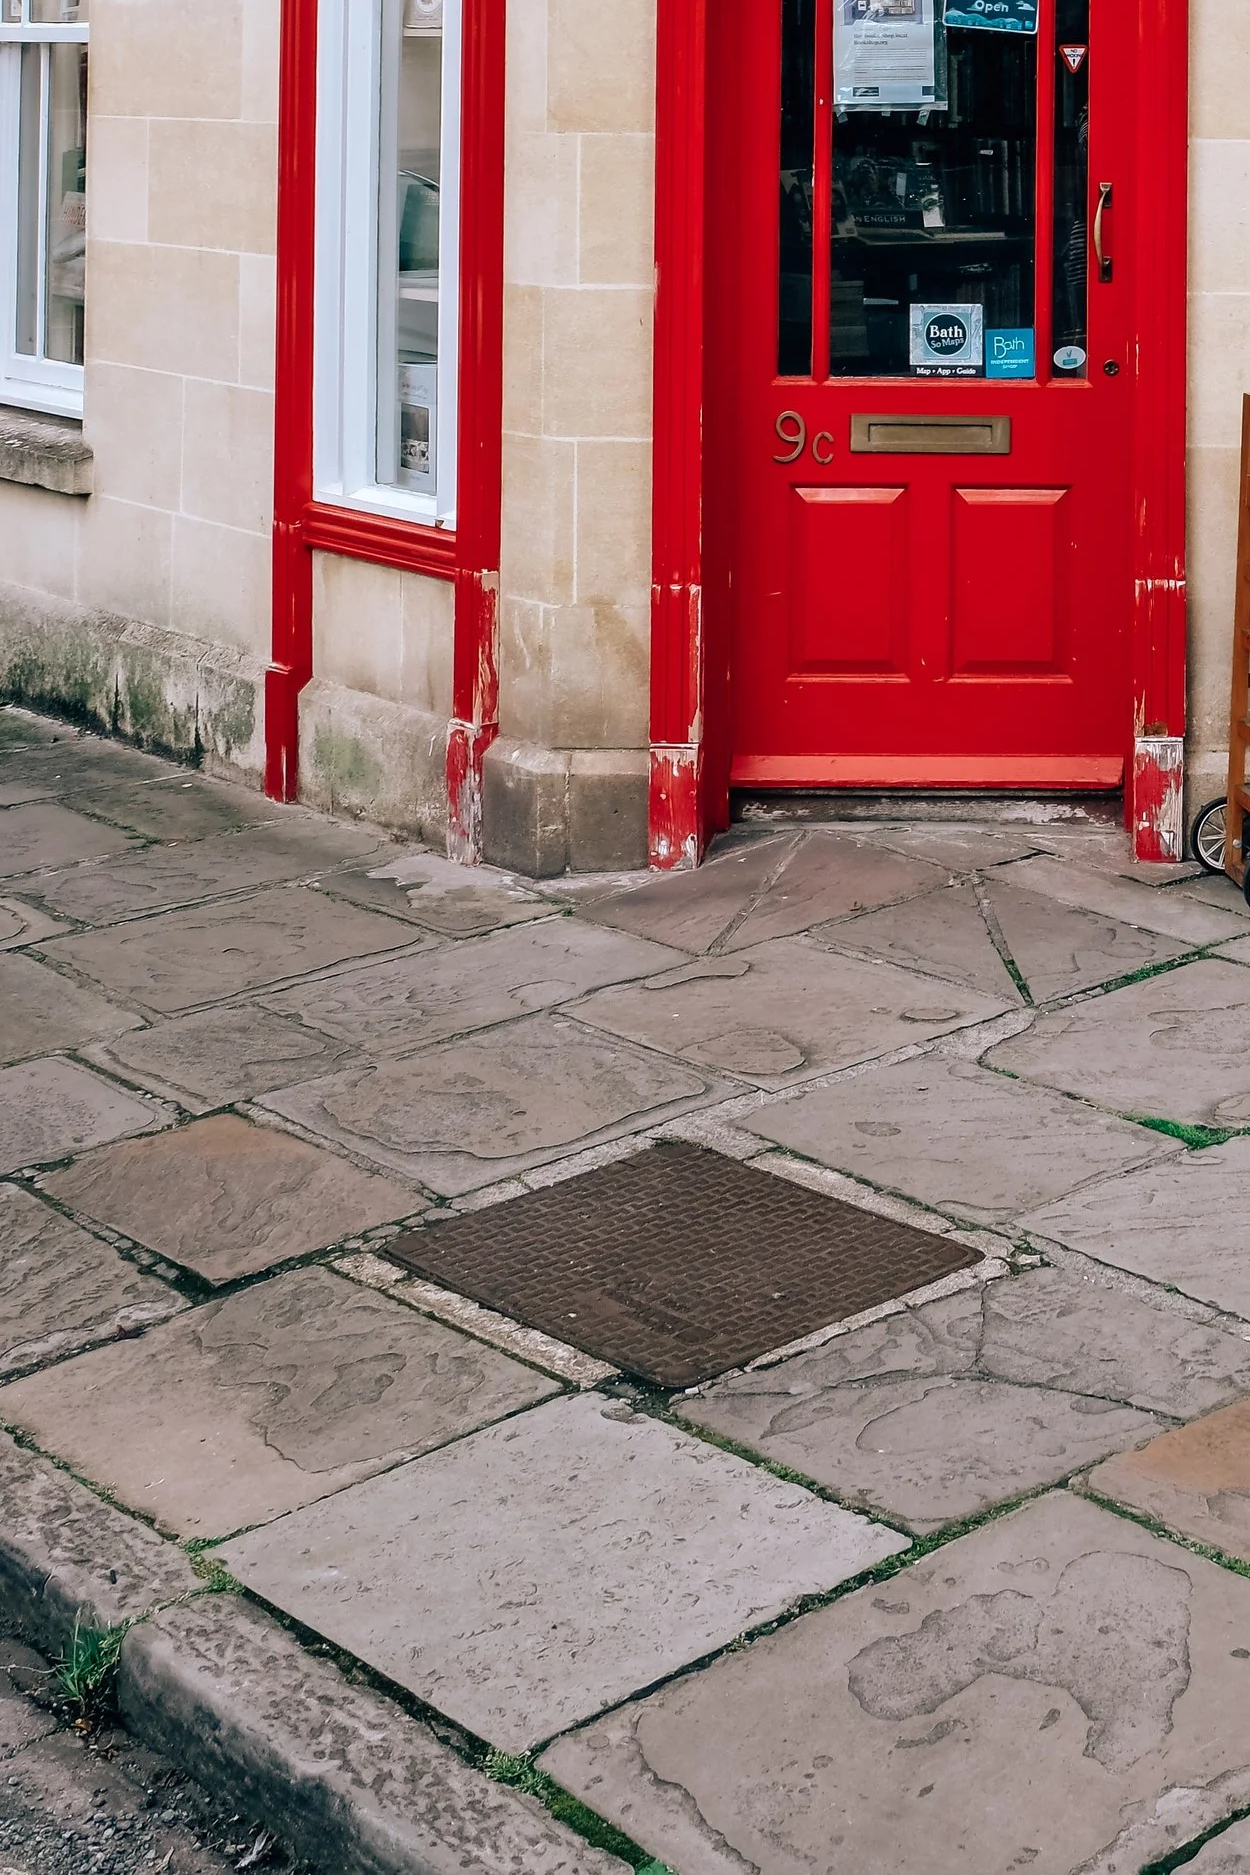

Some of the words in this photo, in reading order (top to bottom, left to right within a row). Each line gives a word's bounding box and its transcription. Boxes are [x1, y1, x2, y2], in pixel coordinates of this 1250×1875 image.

[974, 0, 1009, 14] Open
[864, 214, 906, 223] ENGLISH
[929, 324, 964, 338] Bath
[930, 339, 942, 349] So
[942, 336, 965, 348] Maps
[993, 336, 1025, 359] Bath
[916, 367, 931, 375] Map
[936, 367, 952, 375] App
[956, 367, 977, 375] Guide
[773, 410, 834, 465] 9c
